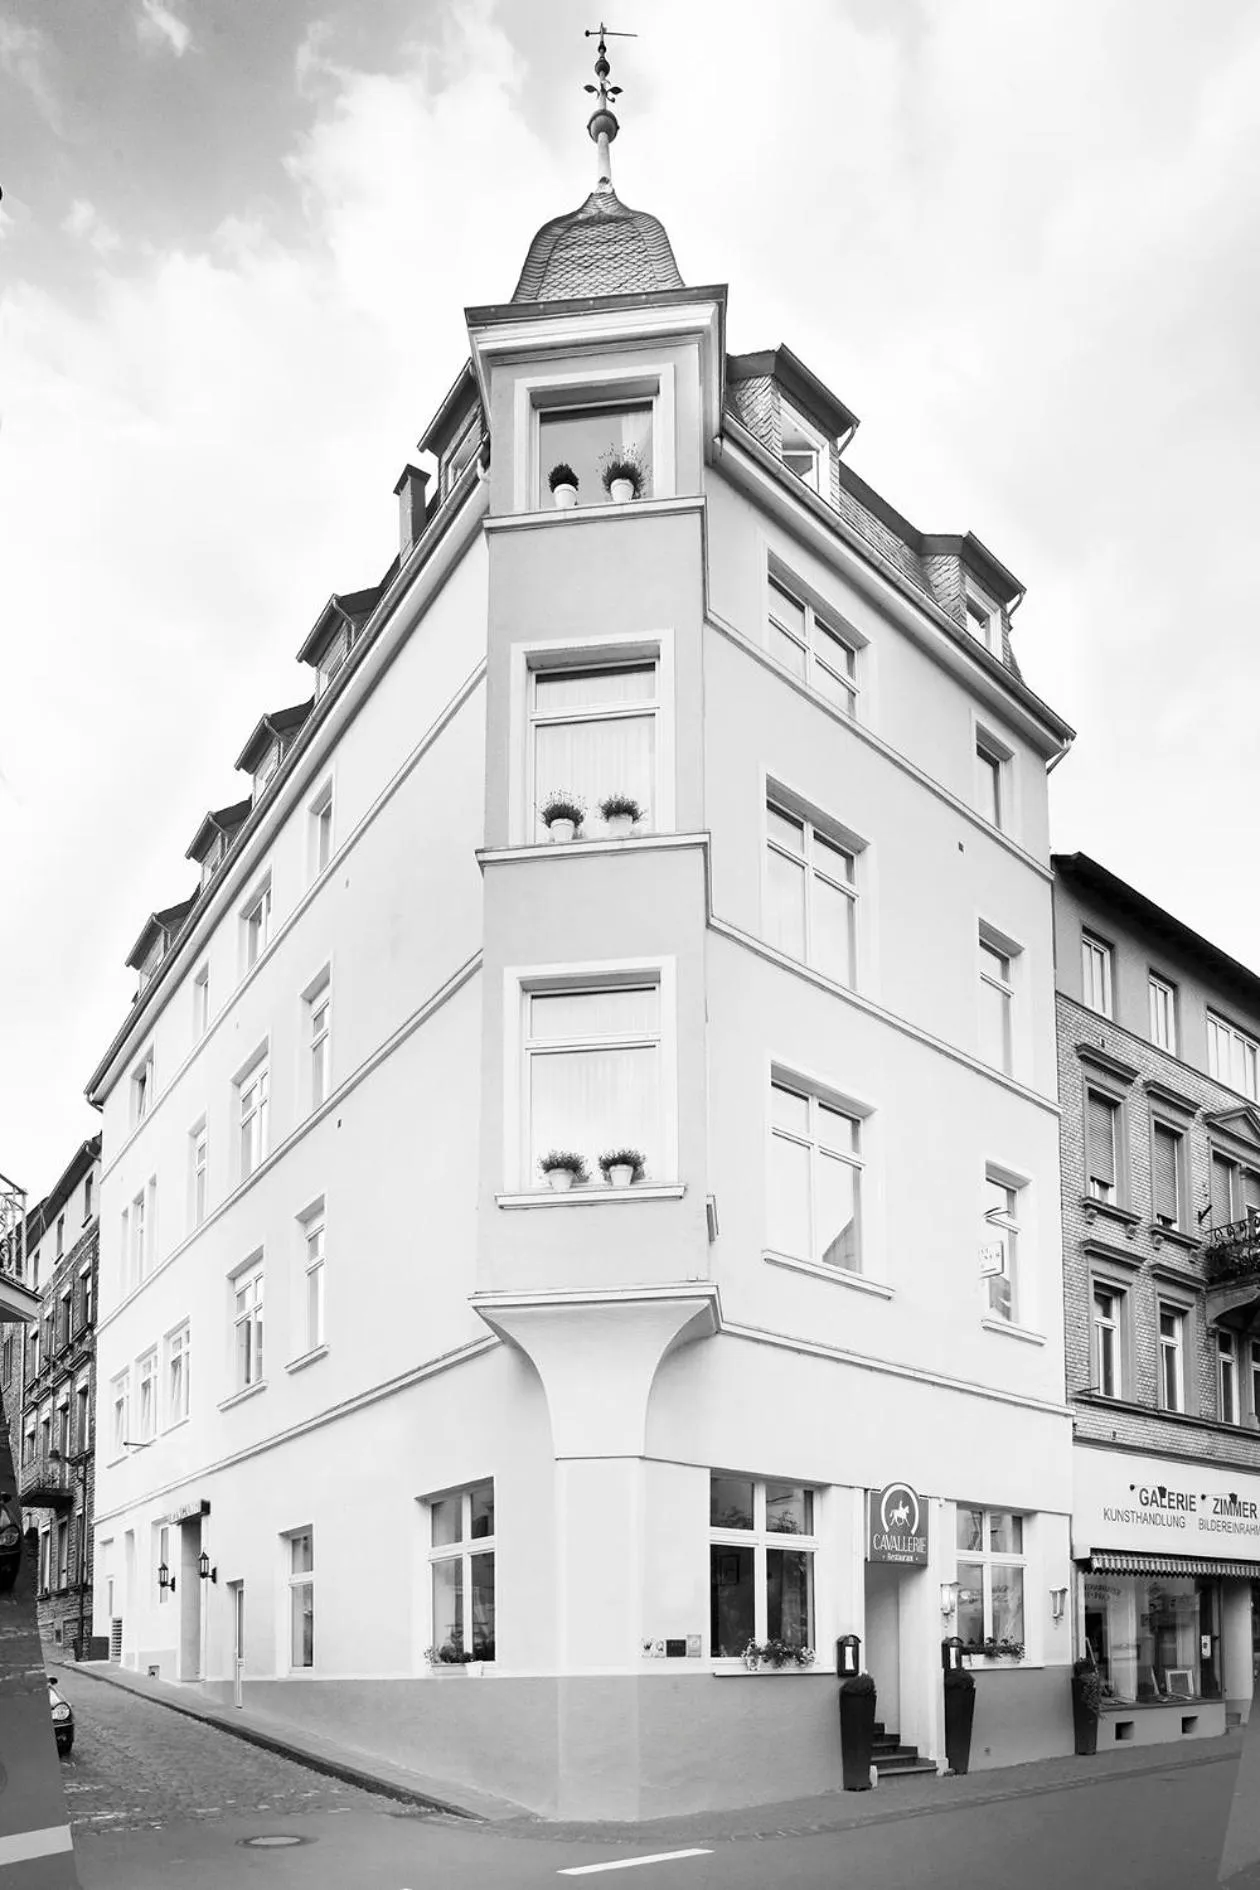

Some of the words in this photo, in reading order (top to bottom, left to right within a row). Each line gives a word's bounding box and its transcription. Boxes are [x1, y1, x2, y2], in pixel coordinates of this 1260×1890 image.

[1139, 1487, 1197, 1512] GALERIE
[1212, 1497, 1257, 1519] ZIMMER
[1103, 1507, 1186, 1528] KUNSTHANDLUNG
[873, 1533, 926, 1553] CAVALLERIE
